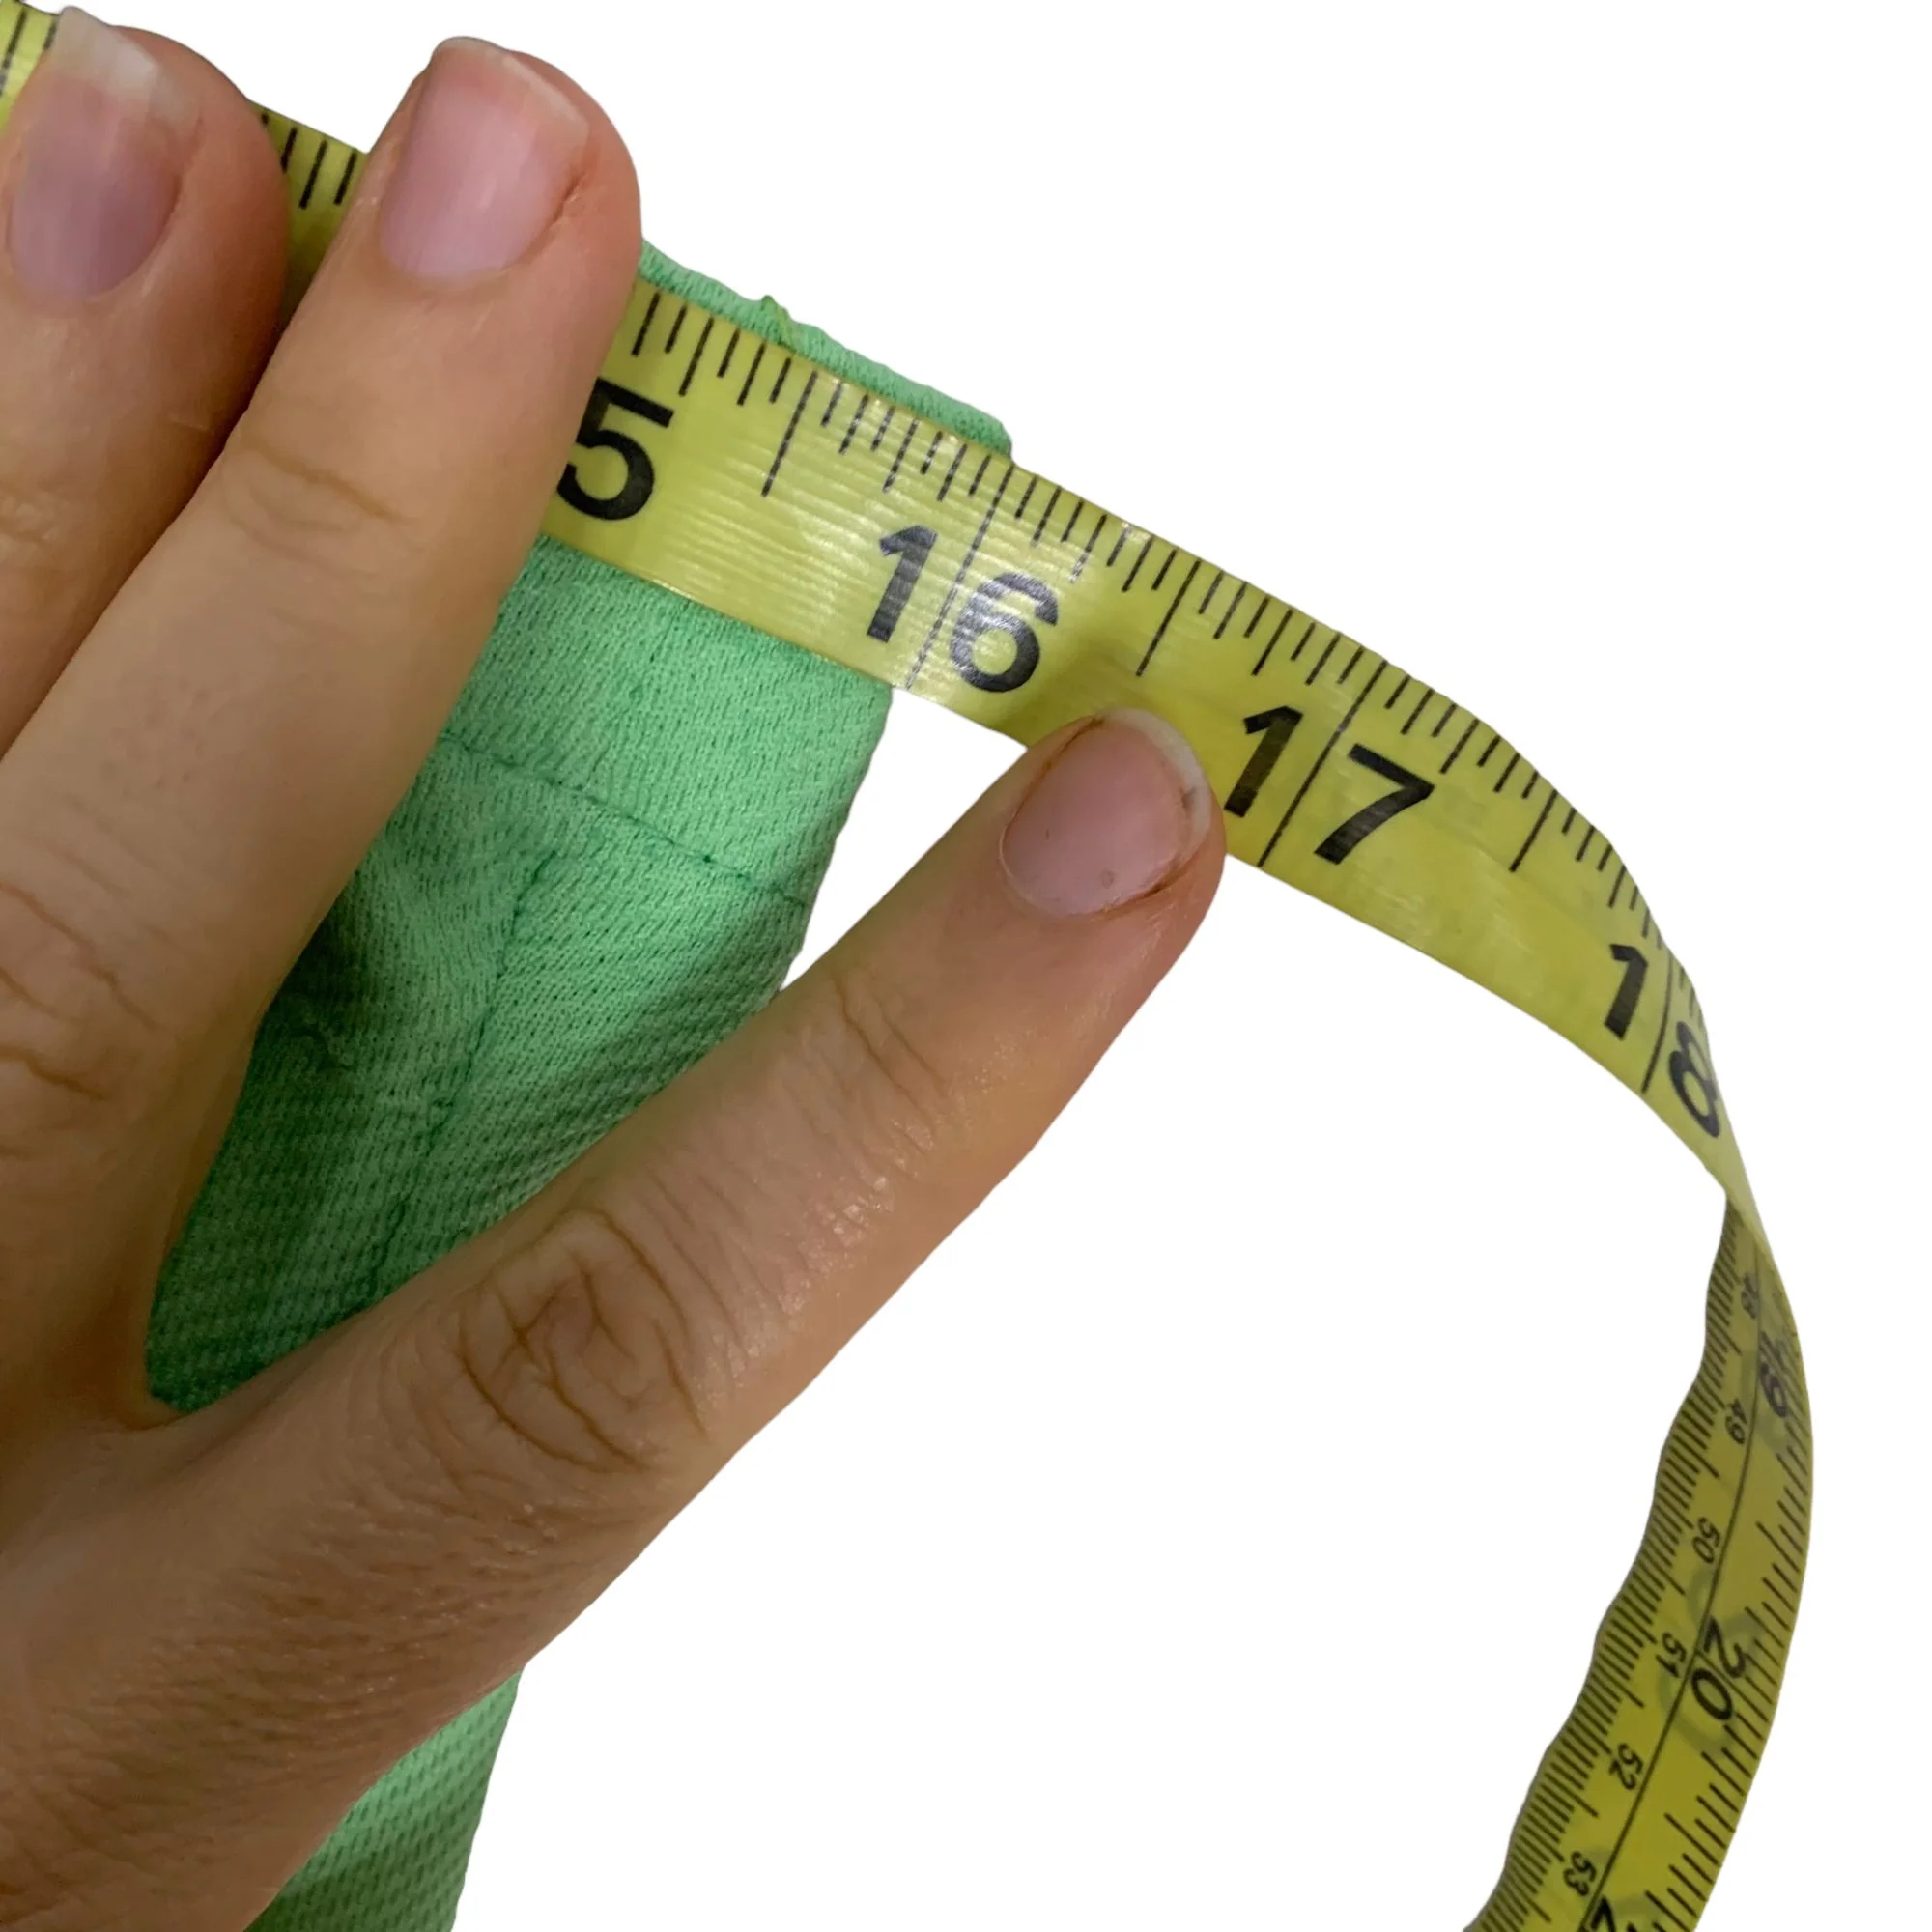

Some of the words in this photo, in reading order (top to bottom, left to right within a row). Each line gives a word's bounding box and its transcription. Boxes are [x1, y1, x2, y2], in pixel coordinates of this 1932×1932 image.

[557, 377, 674, 521] 5
[867, 525, 1058, 693] 16
[1224, 705, 1435, 865] 17
[1604, 944, 1719, 1137] 18
[1724, 1398, 1748, 1444] 49
[1691, 1517, 1720, 1564] 50
[1656, 1633, 1687, 1678] 51
[1691, 1616, 1747, 1720] 20
[1608, 1743, 1643, 1790] 52
[1563, 1852, 1598, 1896] 53
